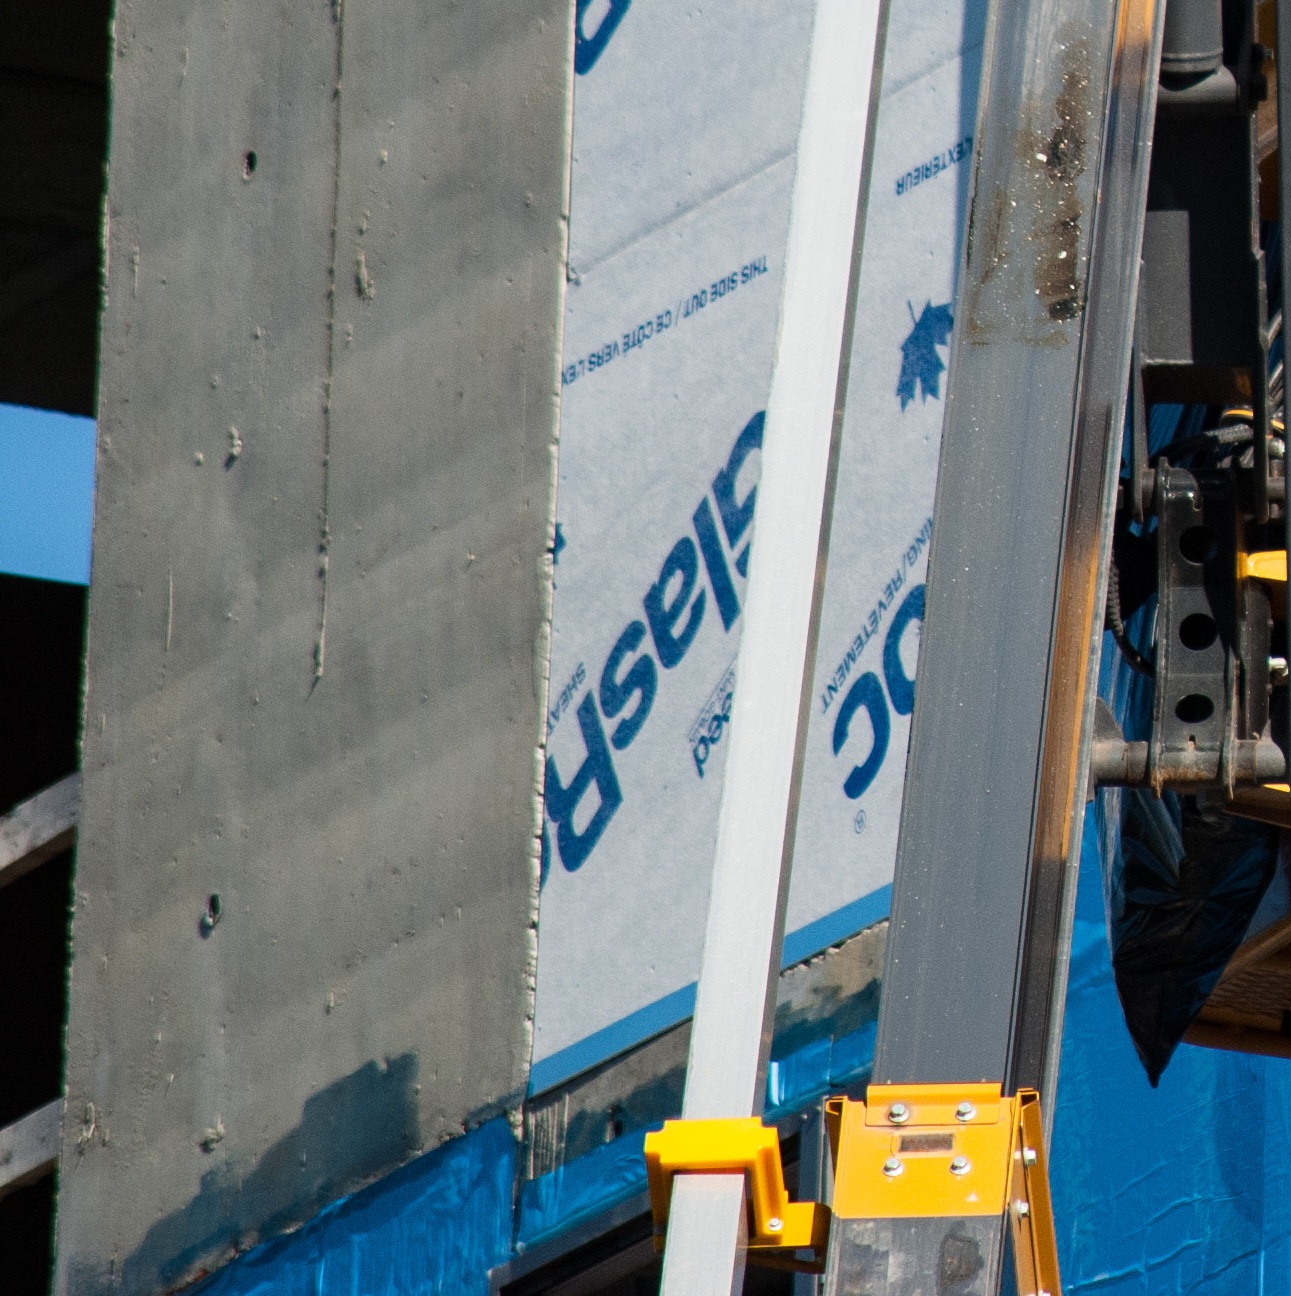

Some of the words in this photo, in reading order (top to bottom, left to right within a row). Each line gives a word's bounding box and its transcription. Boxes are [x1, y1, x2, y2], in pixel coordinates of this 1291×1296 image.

[740, 255, 769, 285] THIS
[709, 272, 739, 303] SIDE
[683, 289, 709, 319] OUT
[655, 309, 674, 335] CE
[587, 340, 621, 373] VERS
[818, 514, 935, 716] ING/REVÊTEMENT
